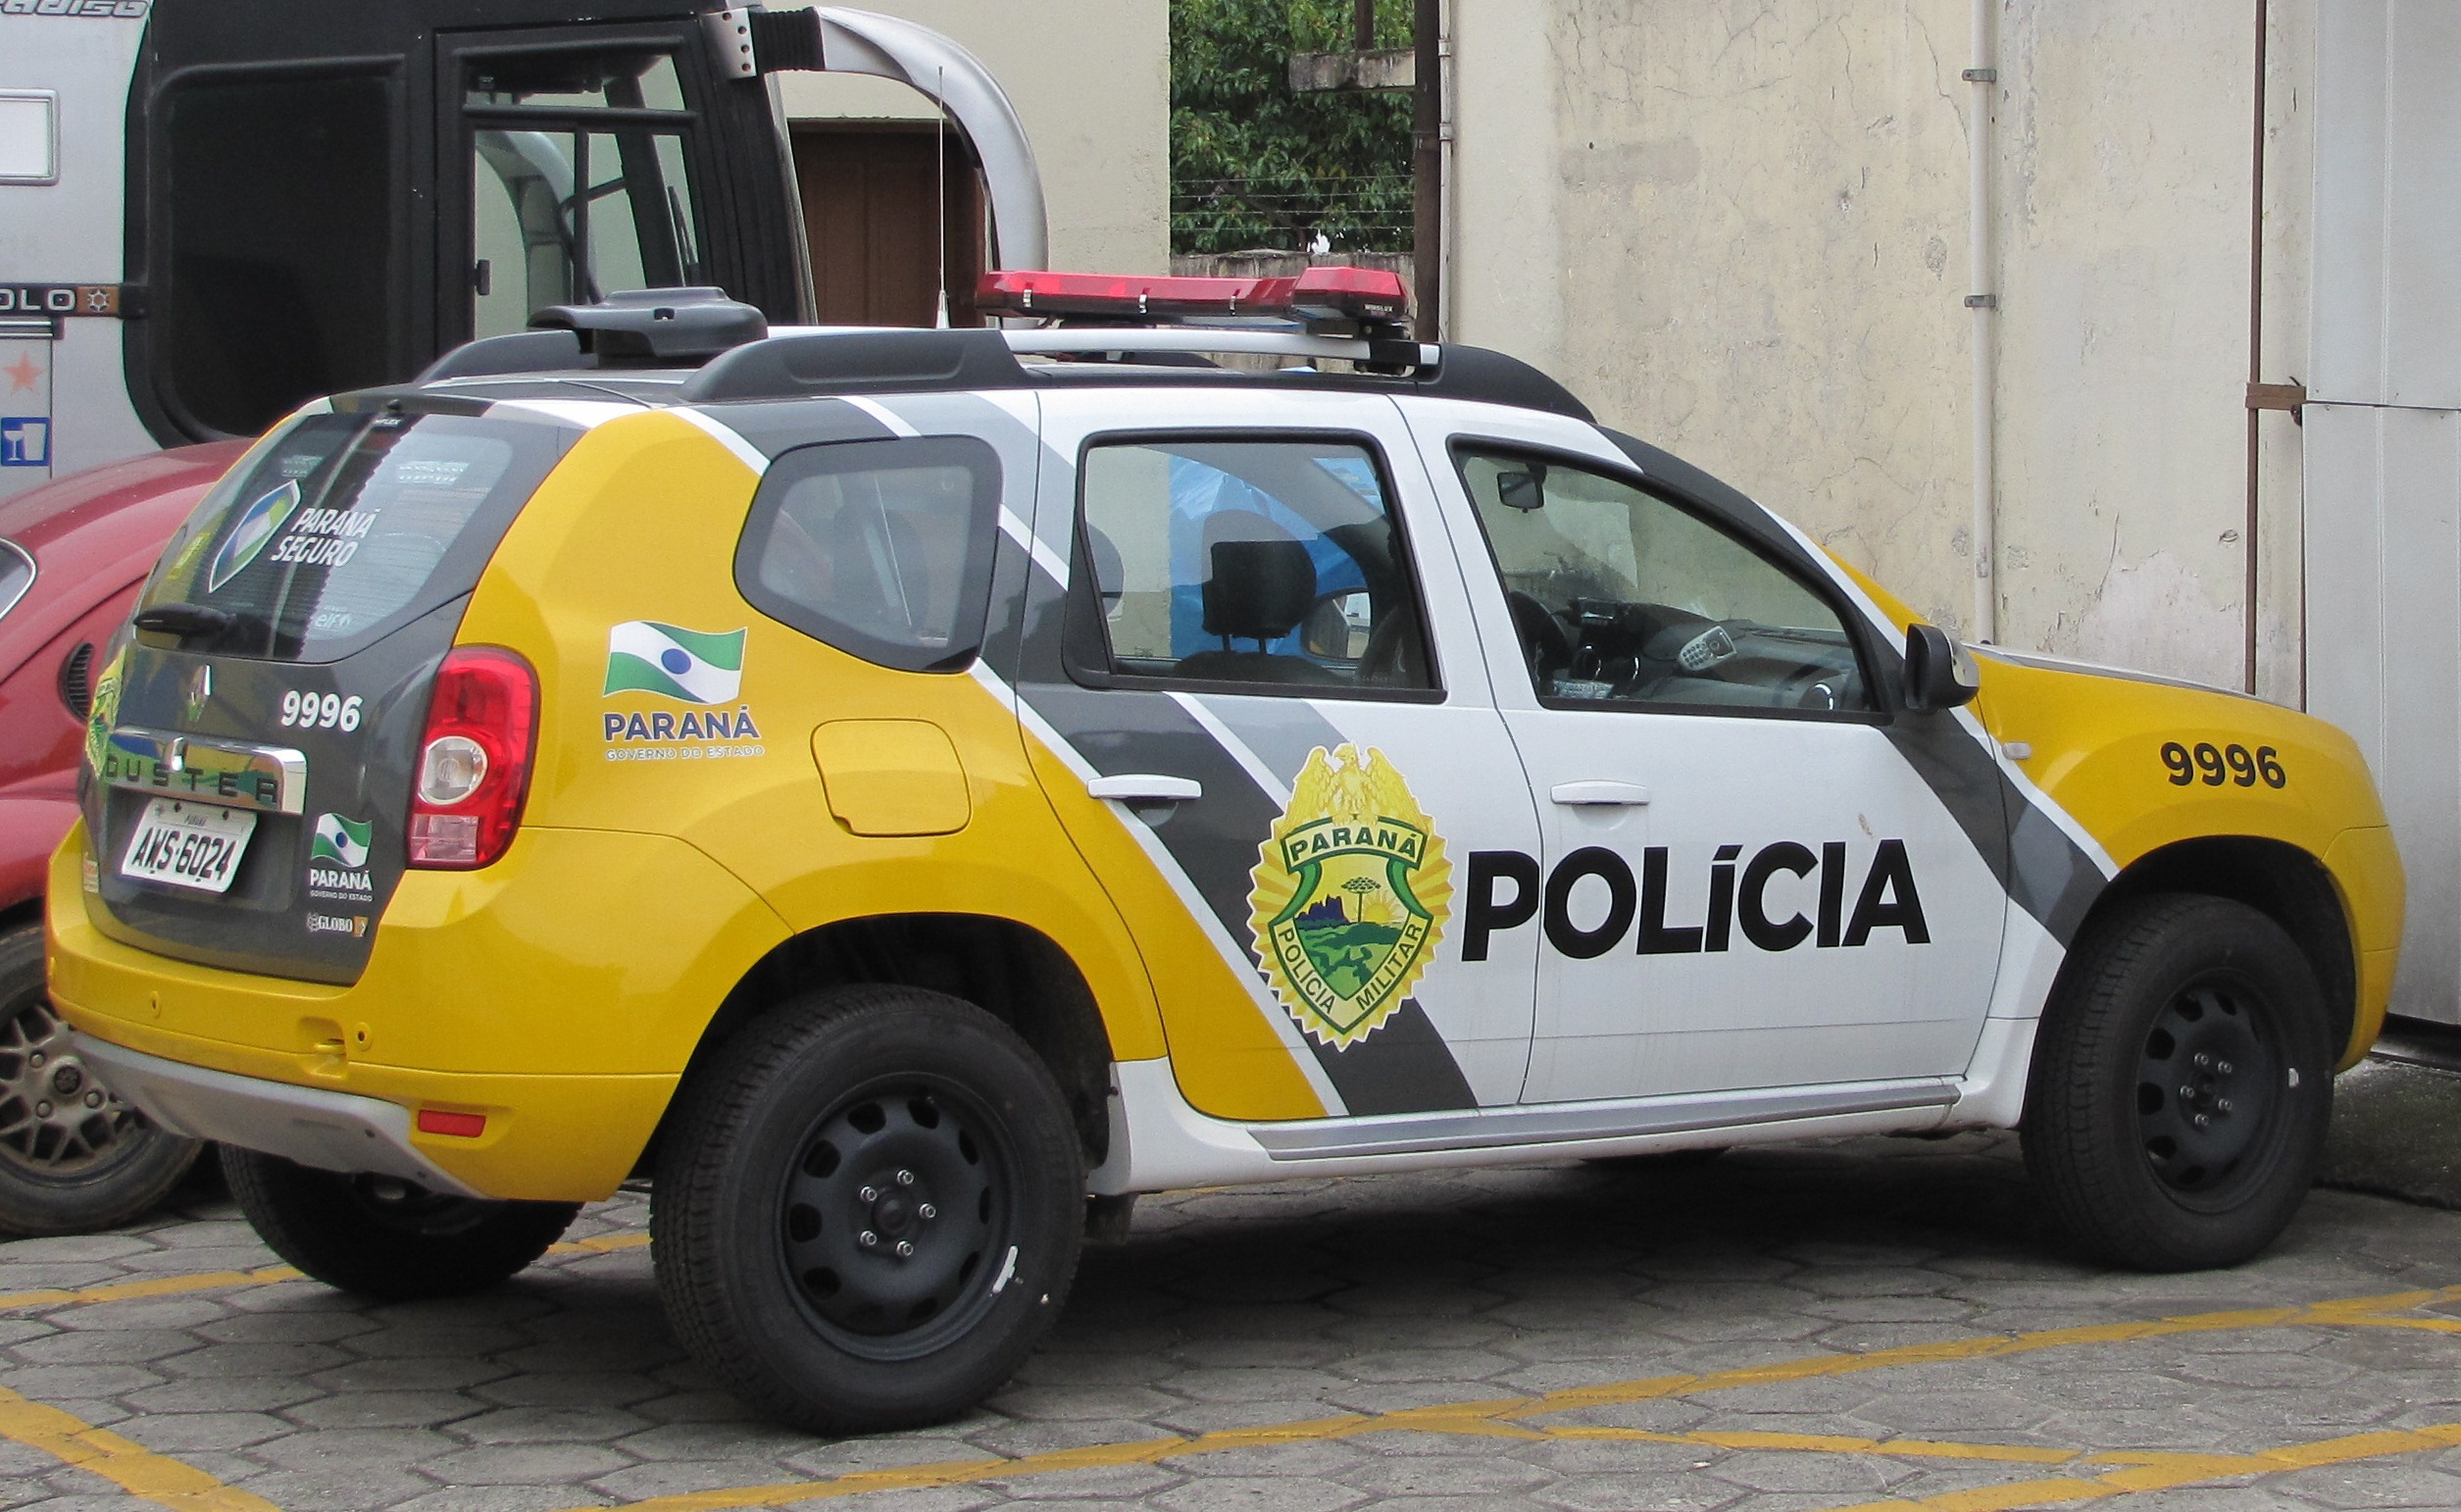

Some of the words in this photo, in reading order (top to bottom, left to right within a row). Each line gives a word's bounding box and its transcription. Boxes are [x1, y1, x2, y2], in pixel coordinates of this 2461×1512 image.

[290, 508, 381, 538] PARANÁ
[271, 535, 359, 567] SEGURO
[280, 690, 364, 732] 9996
[602, 704, 762, 741] PARANÁ
[606, 748, 677, 761] GOVERNO
[681, 747, 702, 758] DO
[707, 745, 765, 757] ESTADO
[2160, 741, 2286, 789] 9996
[106, 754, 278, 806] DUSTER
[1288, 827, 1417, 862] PARANÁ
[310, 868, 374, 891] PARANÁ
[310, 889, 338, 899] GOVERNO
[349, 893, 374, 902] ESTADO
[1461, 838, 1932, 962] POLÍCIA
[319, 915, 354, 933] GLOBO
[1278, 930, 1336, 1015] POLÍCIA
[1355, 923, 1423, 1012] MILITAR
